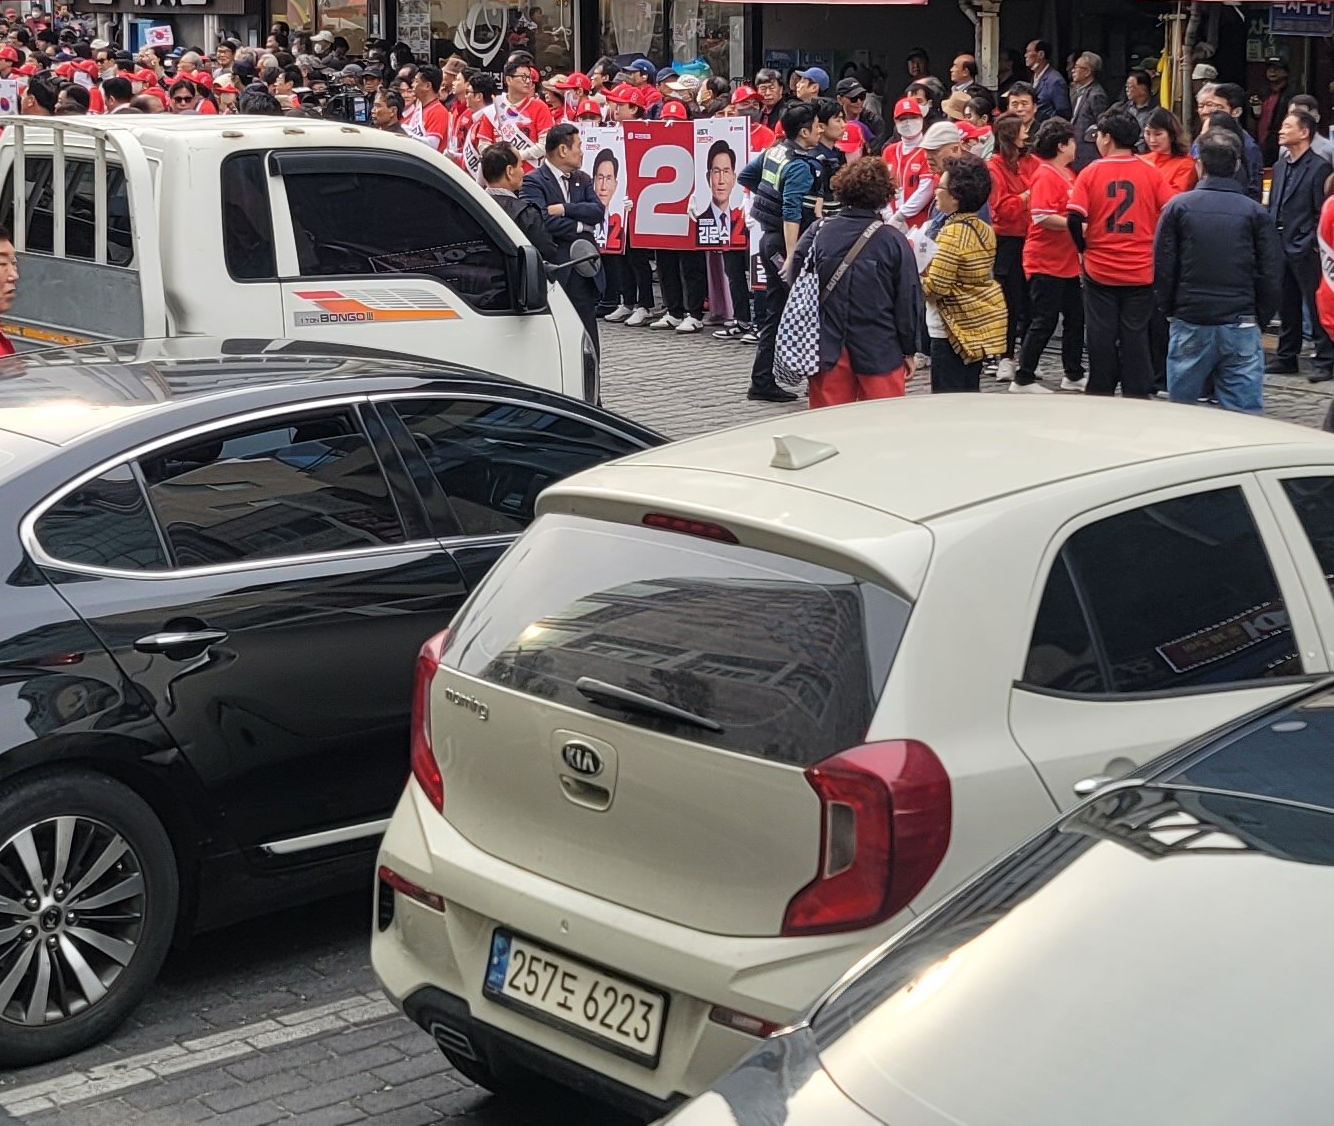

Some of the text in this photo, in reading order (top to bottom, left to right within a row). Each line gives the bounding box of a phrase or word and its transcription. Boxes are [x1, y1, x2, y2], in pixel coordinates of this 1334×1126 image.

[634, 144, 696, 237] 2
[1105, 179, 1136, 234] 2
[698, 225, 730, 245] 김문수
[320, 312, 365, 323] BONGO
[567, 747, 600, 773] KIA
[507, 948, 655, 1044] 257도 6223
